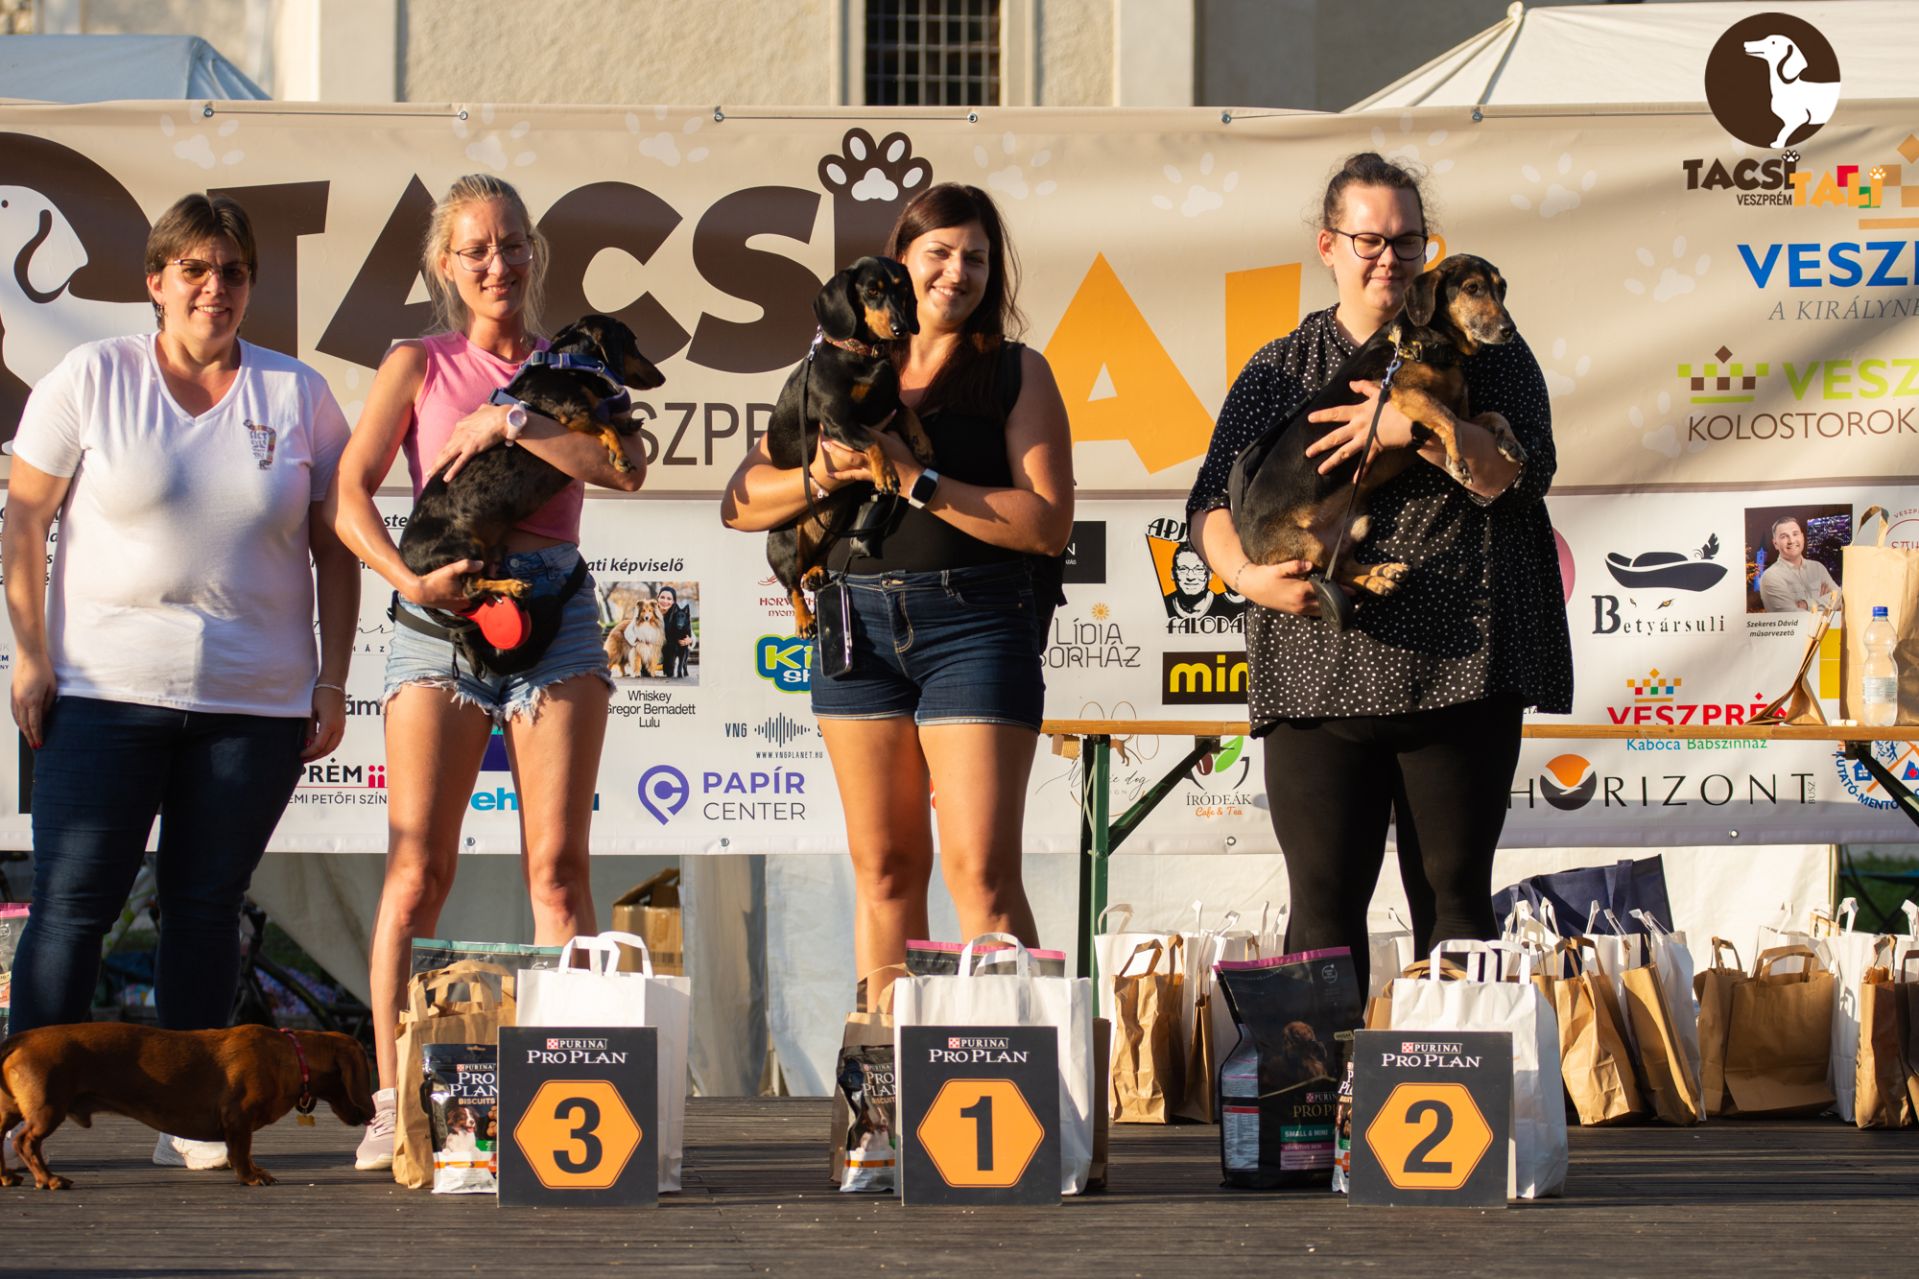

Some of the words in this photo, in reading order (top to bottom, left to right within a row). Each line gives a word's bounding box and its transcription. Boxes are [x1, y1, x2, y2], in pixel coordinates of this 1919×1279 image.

[1737, 241, 1919, 289] VESZ
[1768, 301, 1785, 320] A
[1688, 407, 1918, 441] KOLOSTOROK
[610, 558, 684, 574] képviselő
[1591, 595, 1724, 636] Betyársuli
[1747, 620, 1776, 628] Szekeres
[1777, 619, 1799, 627] Dávid
[1055, 617, 1123, 645] LÍDIA
[628, 690, 671, 704] Whiskey
[607, 704, 641, 717] Gregor
[644, 704, 696, 715] Bernadett
[639, 717, 660, 728] Lulu
[725, 722, 747, 737] VNG
[303, 758, 362, 783] RÉM
[703, 766, 806, 794] PAPÍR
[312, 791, 356, 804] PETŐFI
[360, 792, 387, 804] SZÍN
[1187, 791, 1252, 806] ÍRÓDEÁK
[703, 802, 806, 821] CENTER
[560, 1040, 604, 1048] PURINA
[961, 1039, 1006, 1047] PURINA
[1415, 1043, 1459, 1052] PURINA
[527, 1050, 567, 1064] PRO
[570, 1050, 628, 1064] PLAN
[929, 1049, 968, 1063] PRO
[972, 1049, 1028, 1063] PLAN
[1382, 1053, 1421, 1067] PRO
[1425, 1053, 1481, 1067] PLAN
[458, 1072, 495, 1084] PRO
[866, 1071, 894, 1085] PRO
[1293, 1104, 1322, 1118] PRO
[553, 1097, 603, 1174] 3
[960, 1096, 994, 1171] 1
[1284, 1130, 1306, 1138] SMALL
[1403, 1100, 1454, 1174] 2
